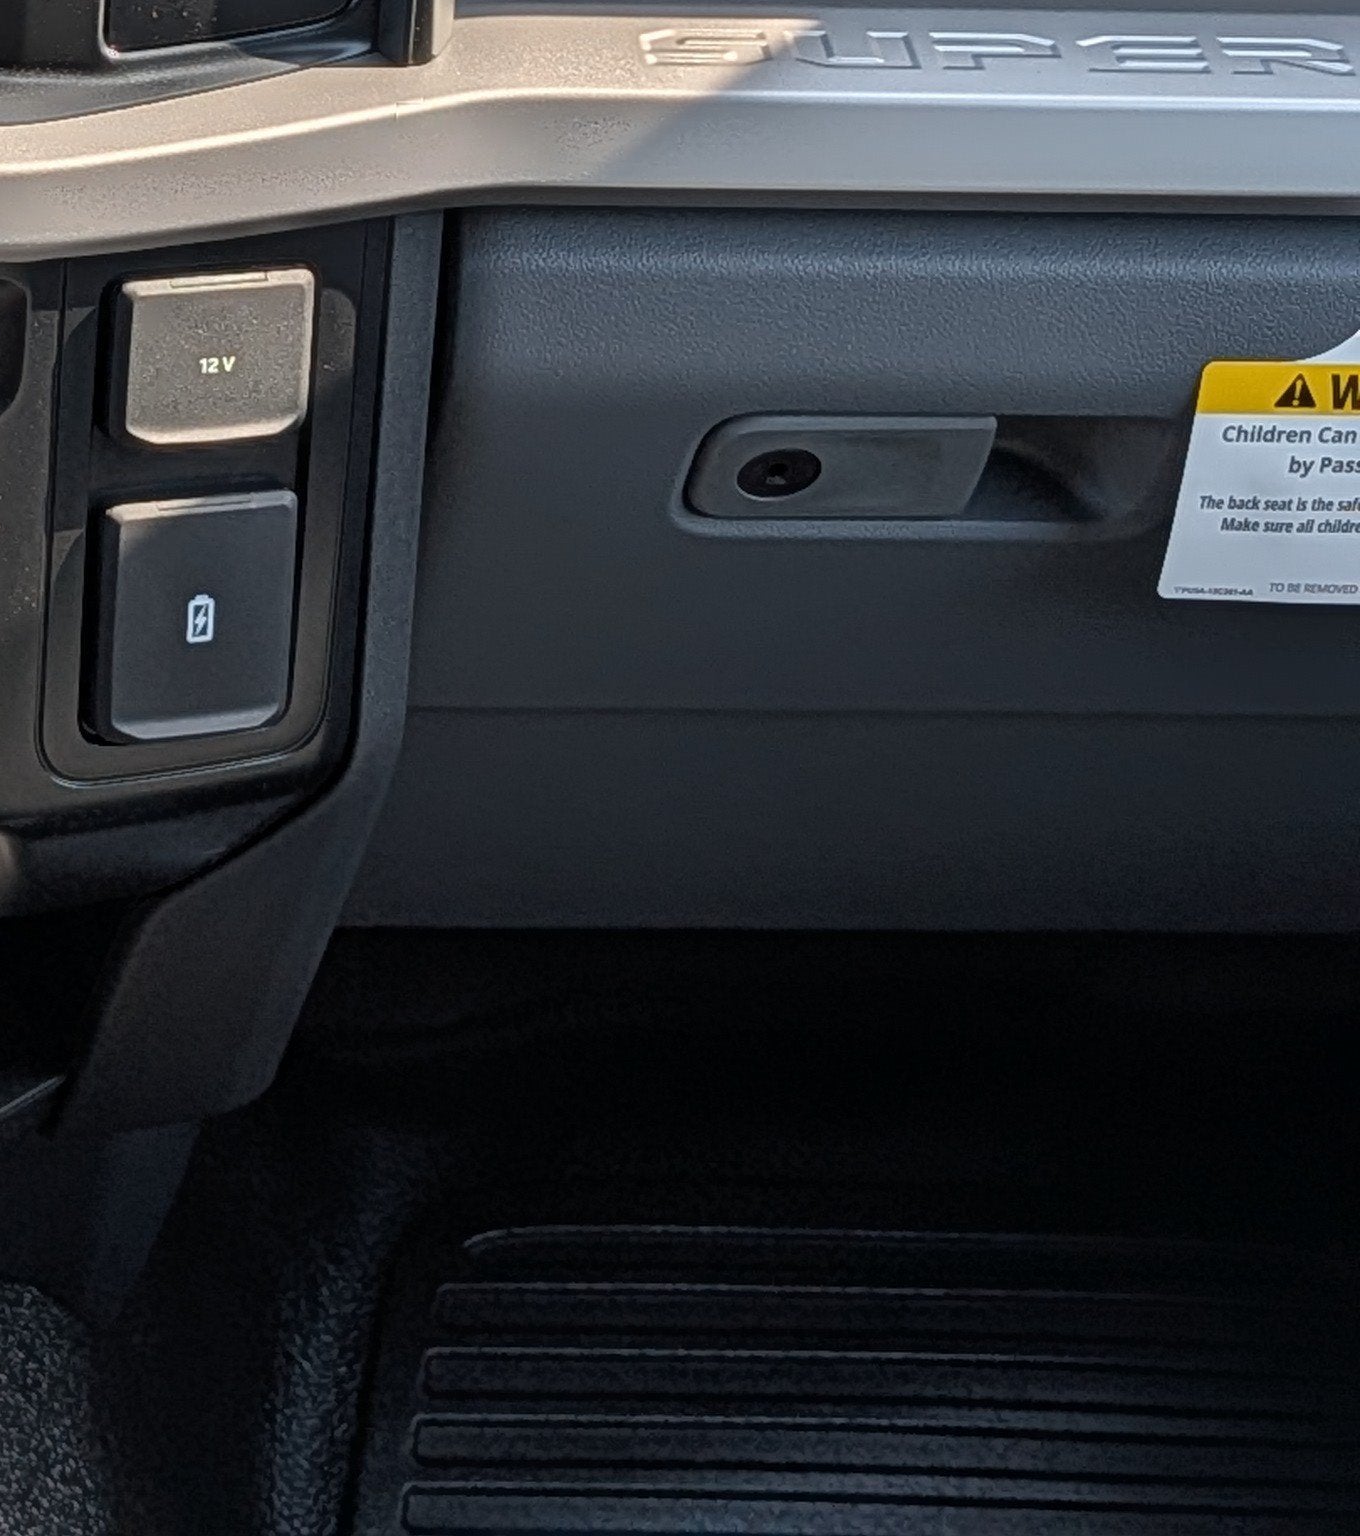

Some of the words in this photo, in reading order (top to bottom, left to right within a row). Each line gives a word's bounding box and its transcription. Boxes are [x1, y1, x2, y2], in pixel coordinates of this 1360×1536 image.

[639, 27, 1356, 77] SUPER
[199, 356, 221, 375] 12
[221, 355, 236, 373] V
[1222, 424, 1312, 443] Children
[1318, 426, 1358, 444] Can
[1288, 455, 1315, 479] by
[1199, 494, 1224, 511] The
[1227, 495, 1261, 512] back
[1263, 496, 1294, 512] seat
[1296, 496, 1309, 512] is
[1311, 497, 1334, 512] the
[1220, 517, 1261, 533] Make
[1262, 520, 1294, 534] sure
[1296, 519, 1316, 534] all
[1270, 582, 1285, 593] TO
[1287, 582, 1301, 594] BE
[1303, 583, 1359, 595] REMOVED
